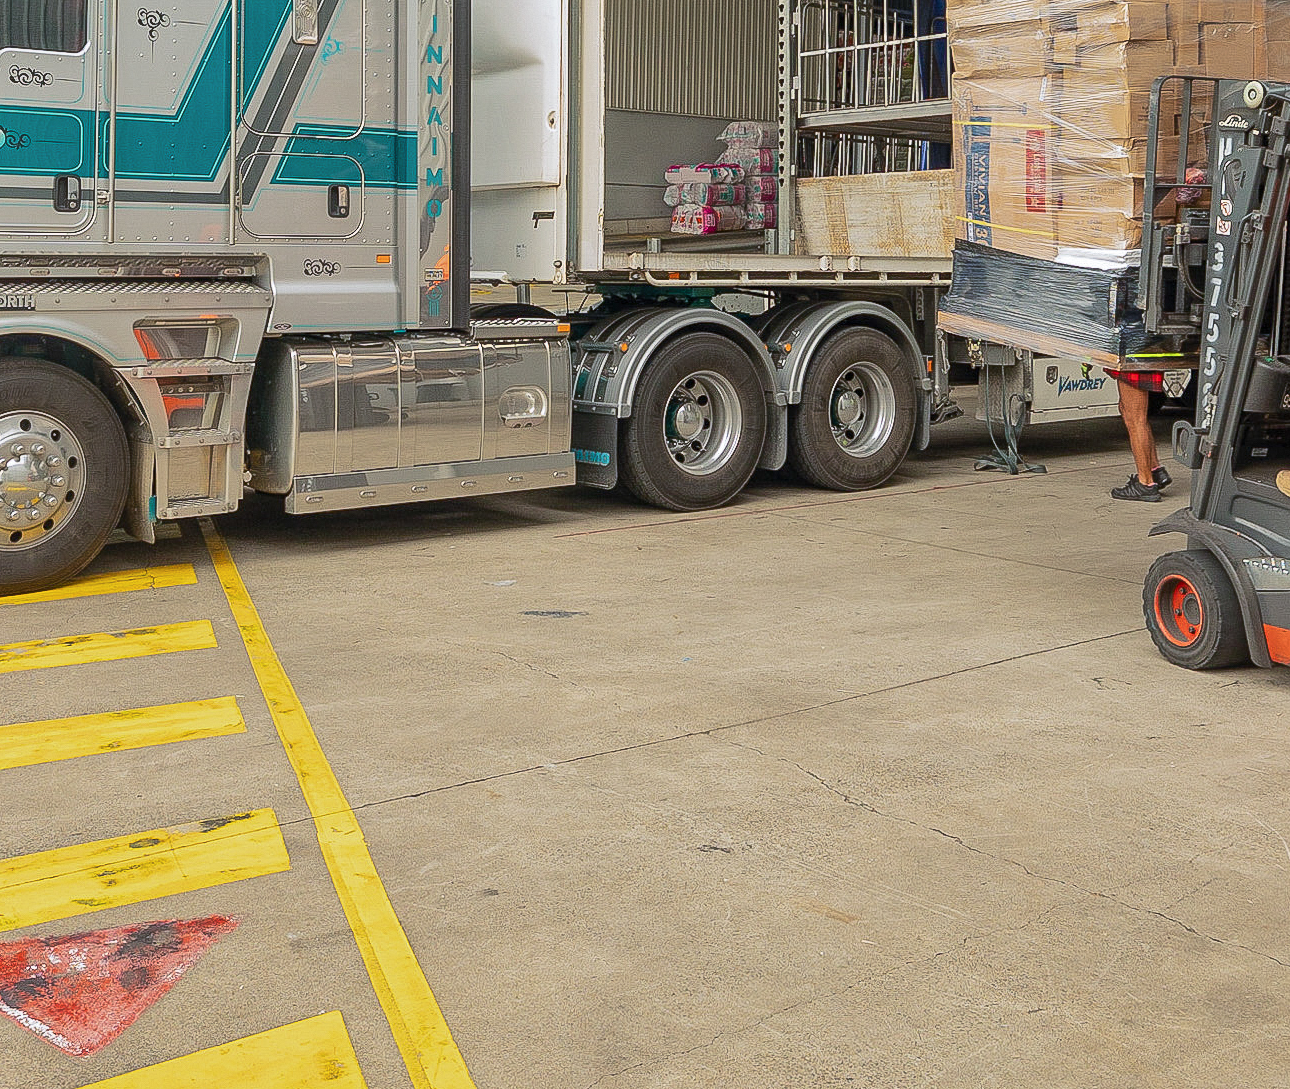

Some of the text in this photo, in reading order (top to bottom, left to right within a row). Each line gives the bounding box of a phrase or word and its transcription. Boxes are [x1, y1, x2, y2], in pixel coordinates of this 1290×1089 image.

[426, 14, 443, 218] INNAIMO
[1219, 114, 1249, 129] Linde
[1057, 376, 1107, 397] VAWDREY
